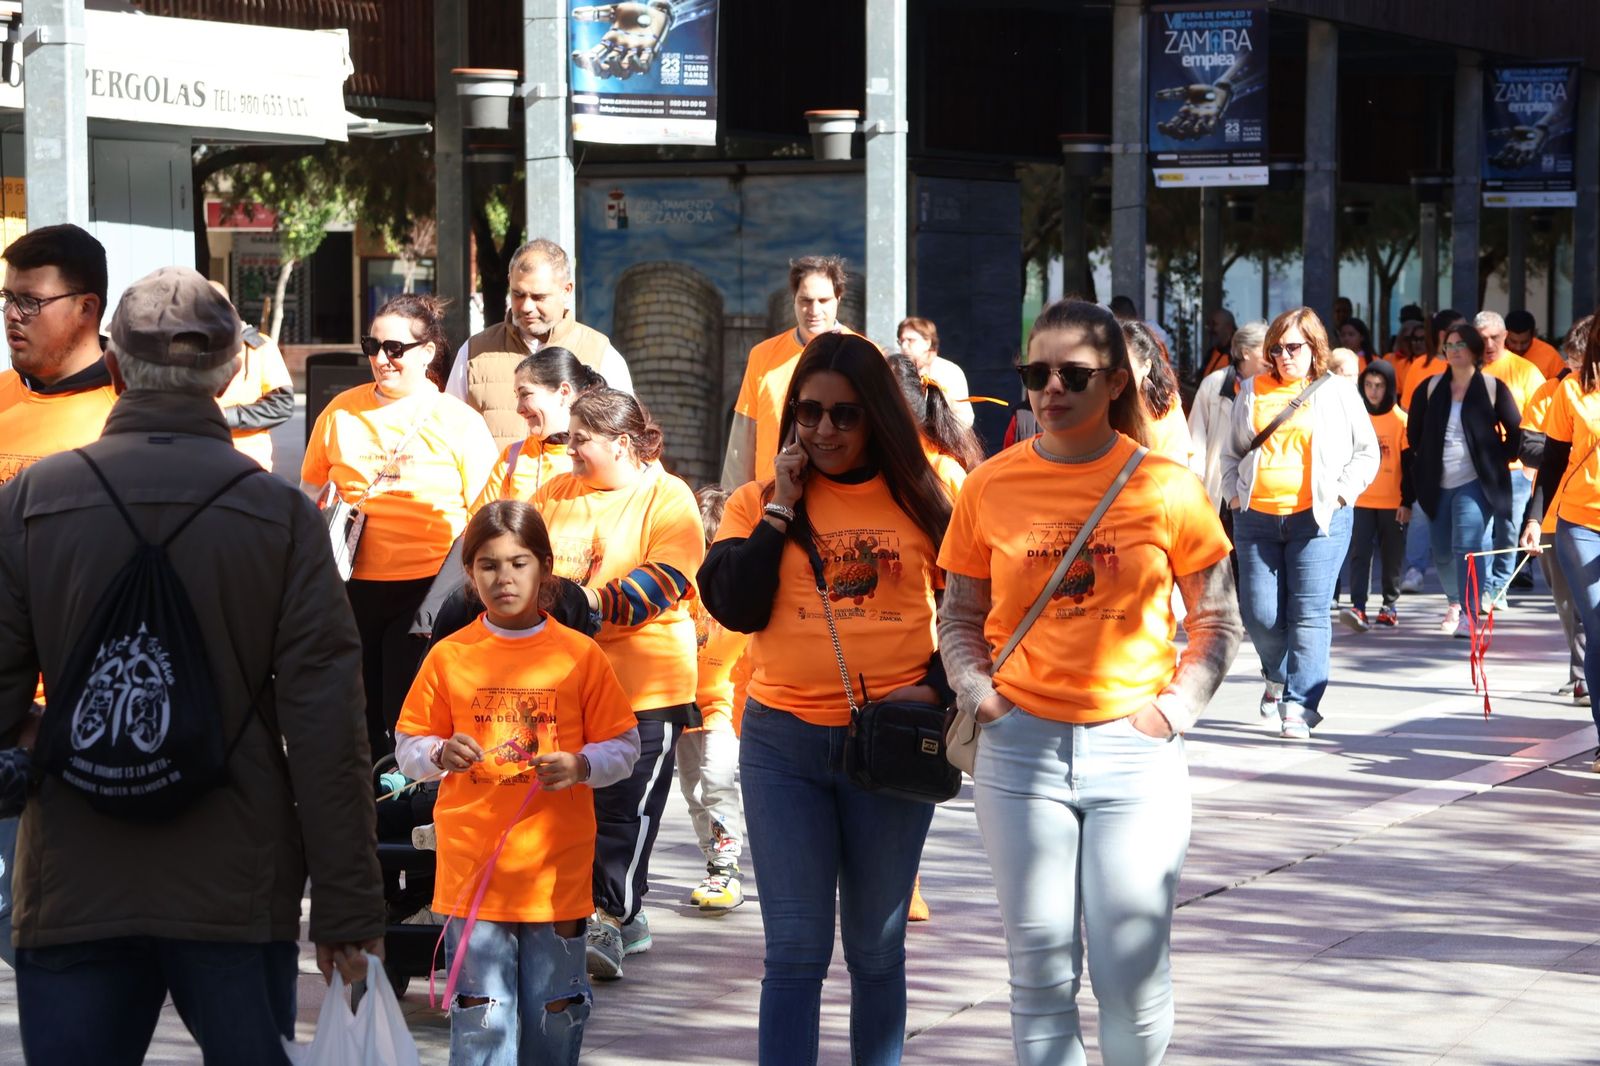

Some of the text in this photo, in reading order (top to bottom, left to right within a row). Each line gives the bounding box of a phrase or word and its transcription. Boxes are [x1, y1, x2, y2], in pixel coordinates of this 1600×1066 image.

[1215, 10, 1246, 19] EMPLEO
[1182, 19, 1253, 29] EMPRENDIMIENTO
[1164, 28, 1253, 54] ZAMORA
[660, 58, 680, 73] 23
[1182, 51, 1236, 71] emplea
[1225, 122, 1240, 134] 23
[656, 210, 714, 224] ZAMORA
[1027, 549, 1049, 558] DIA
[474, 714, 492, 723] DIA
[496, 714, 519, 724] DEL
